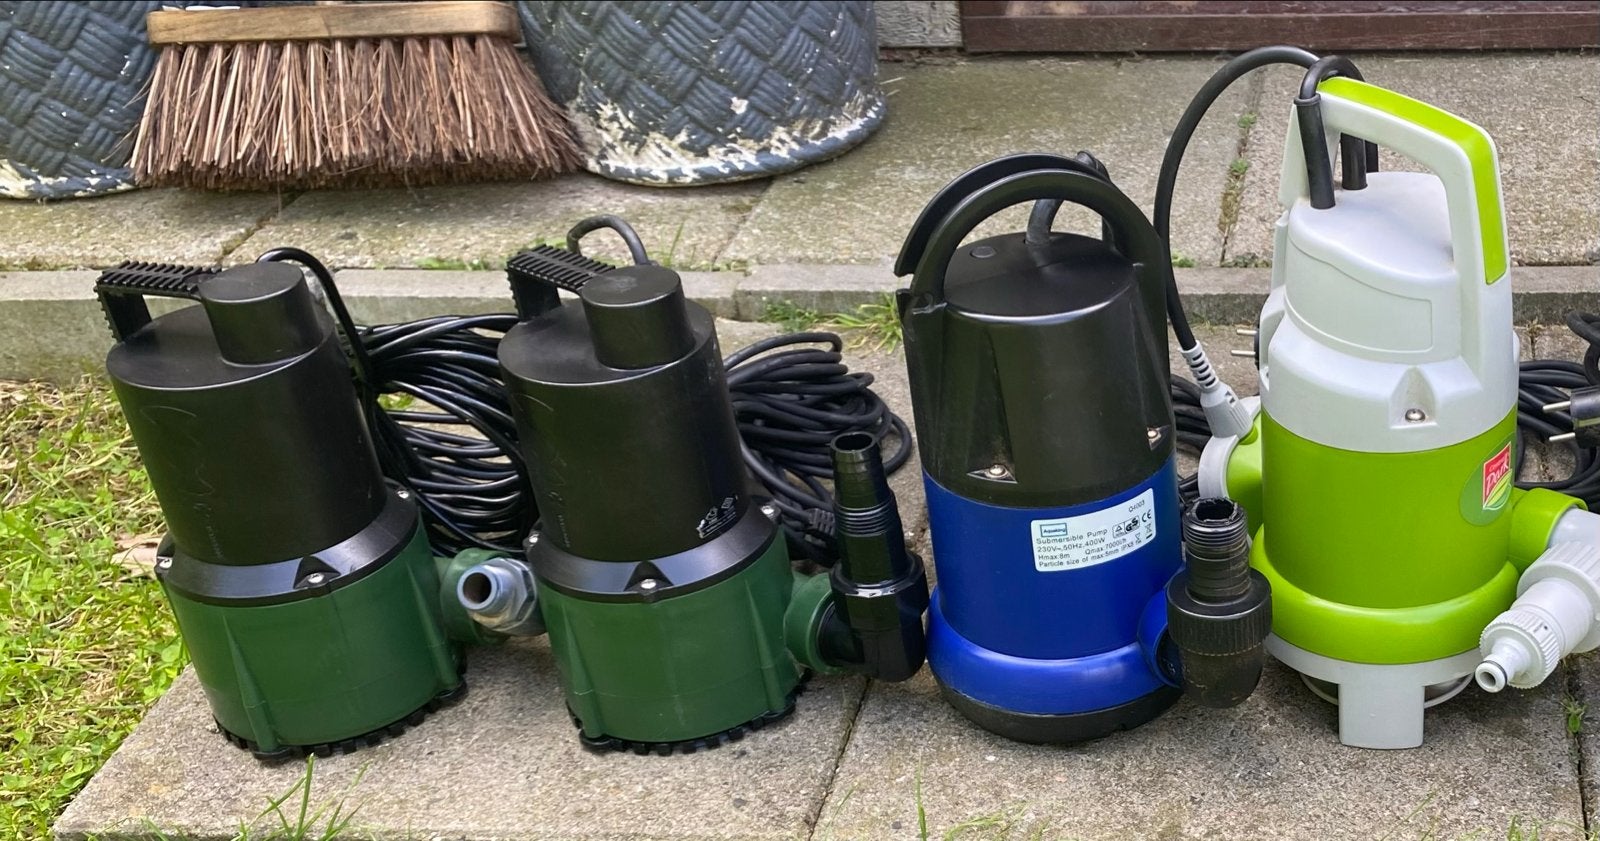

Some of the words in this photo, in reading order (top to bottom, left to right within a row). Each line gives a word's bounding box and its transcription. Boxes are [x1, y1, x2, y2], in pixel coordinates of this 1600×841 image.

[1486, 452, 1509, 496] Park
[1036, 535, 1083, 545] Submersible
[1087, 529, 1108, 538] Pump
